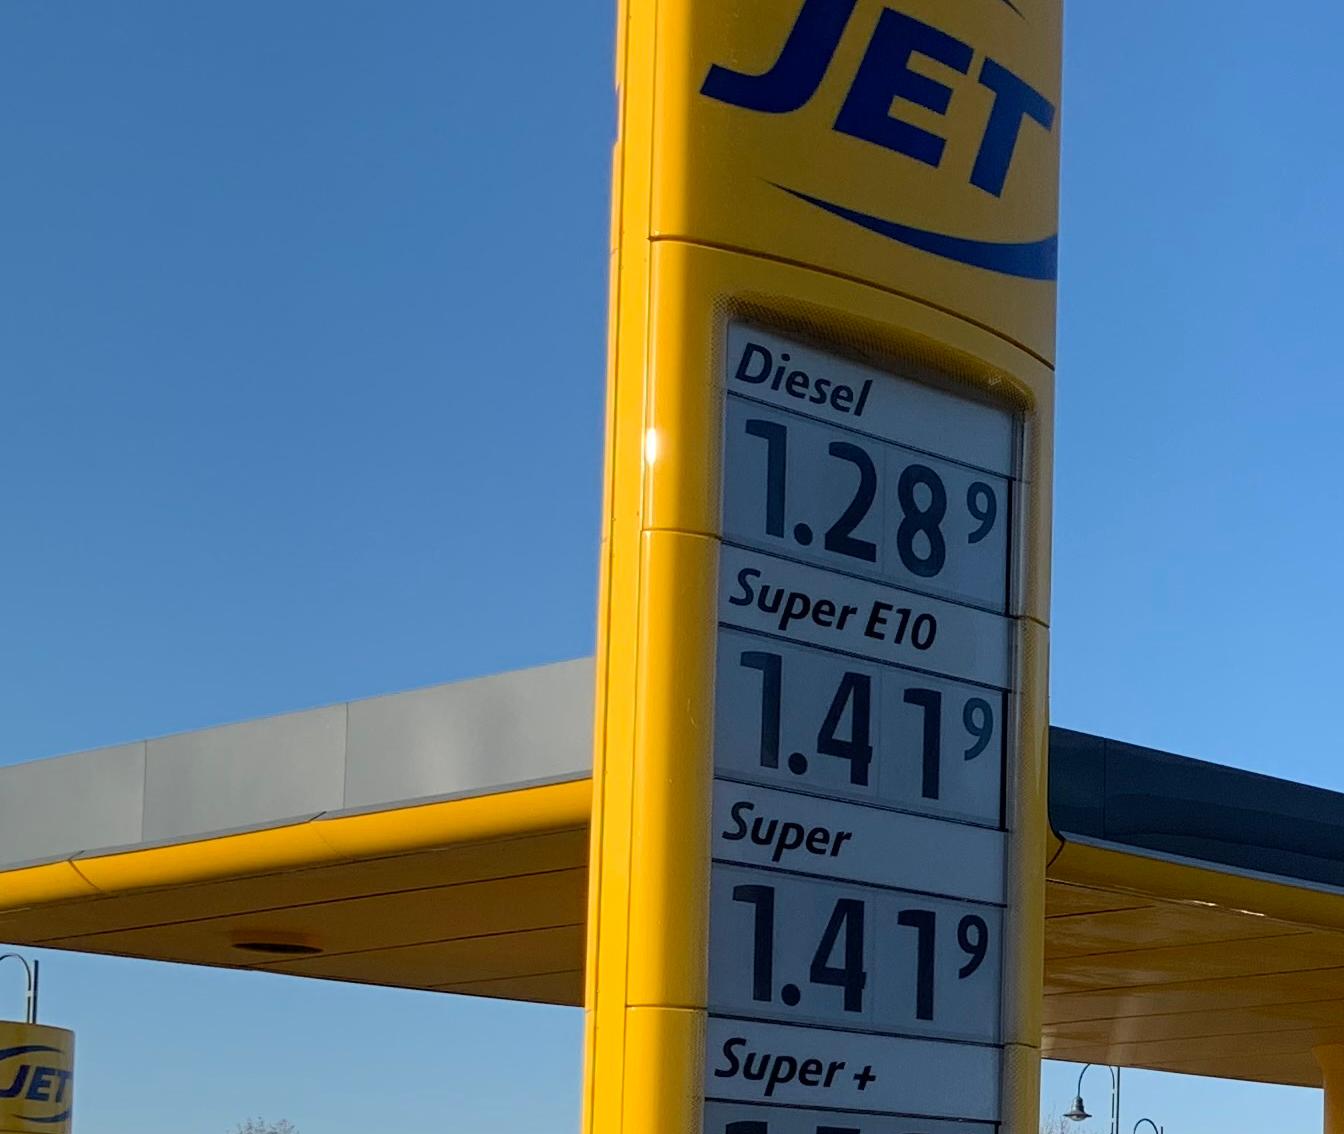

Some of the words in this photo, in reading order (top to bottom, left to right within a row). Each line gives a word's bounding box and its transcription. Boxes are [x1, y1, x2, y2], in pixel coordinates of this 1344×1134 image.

[700, 0, 1055, 198] JET
[734, 342, 872, 418] Diesel
[728, 567, 857, 633] Super
[864, 605, 937, 651] E10
[721, 801, 852, 862] Super
[0, 1064, 72, 1103] JET
[714, 1037, 846, 1097] Super
